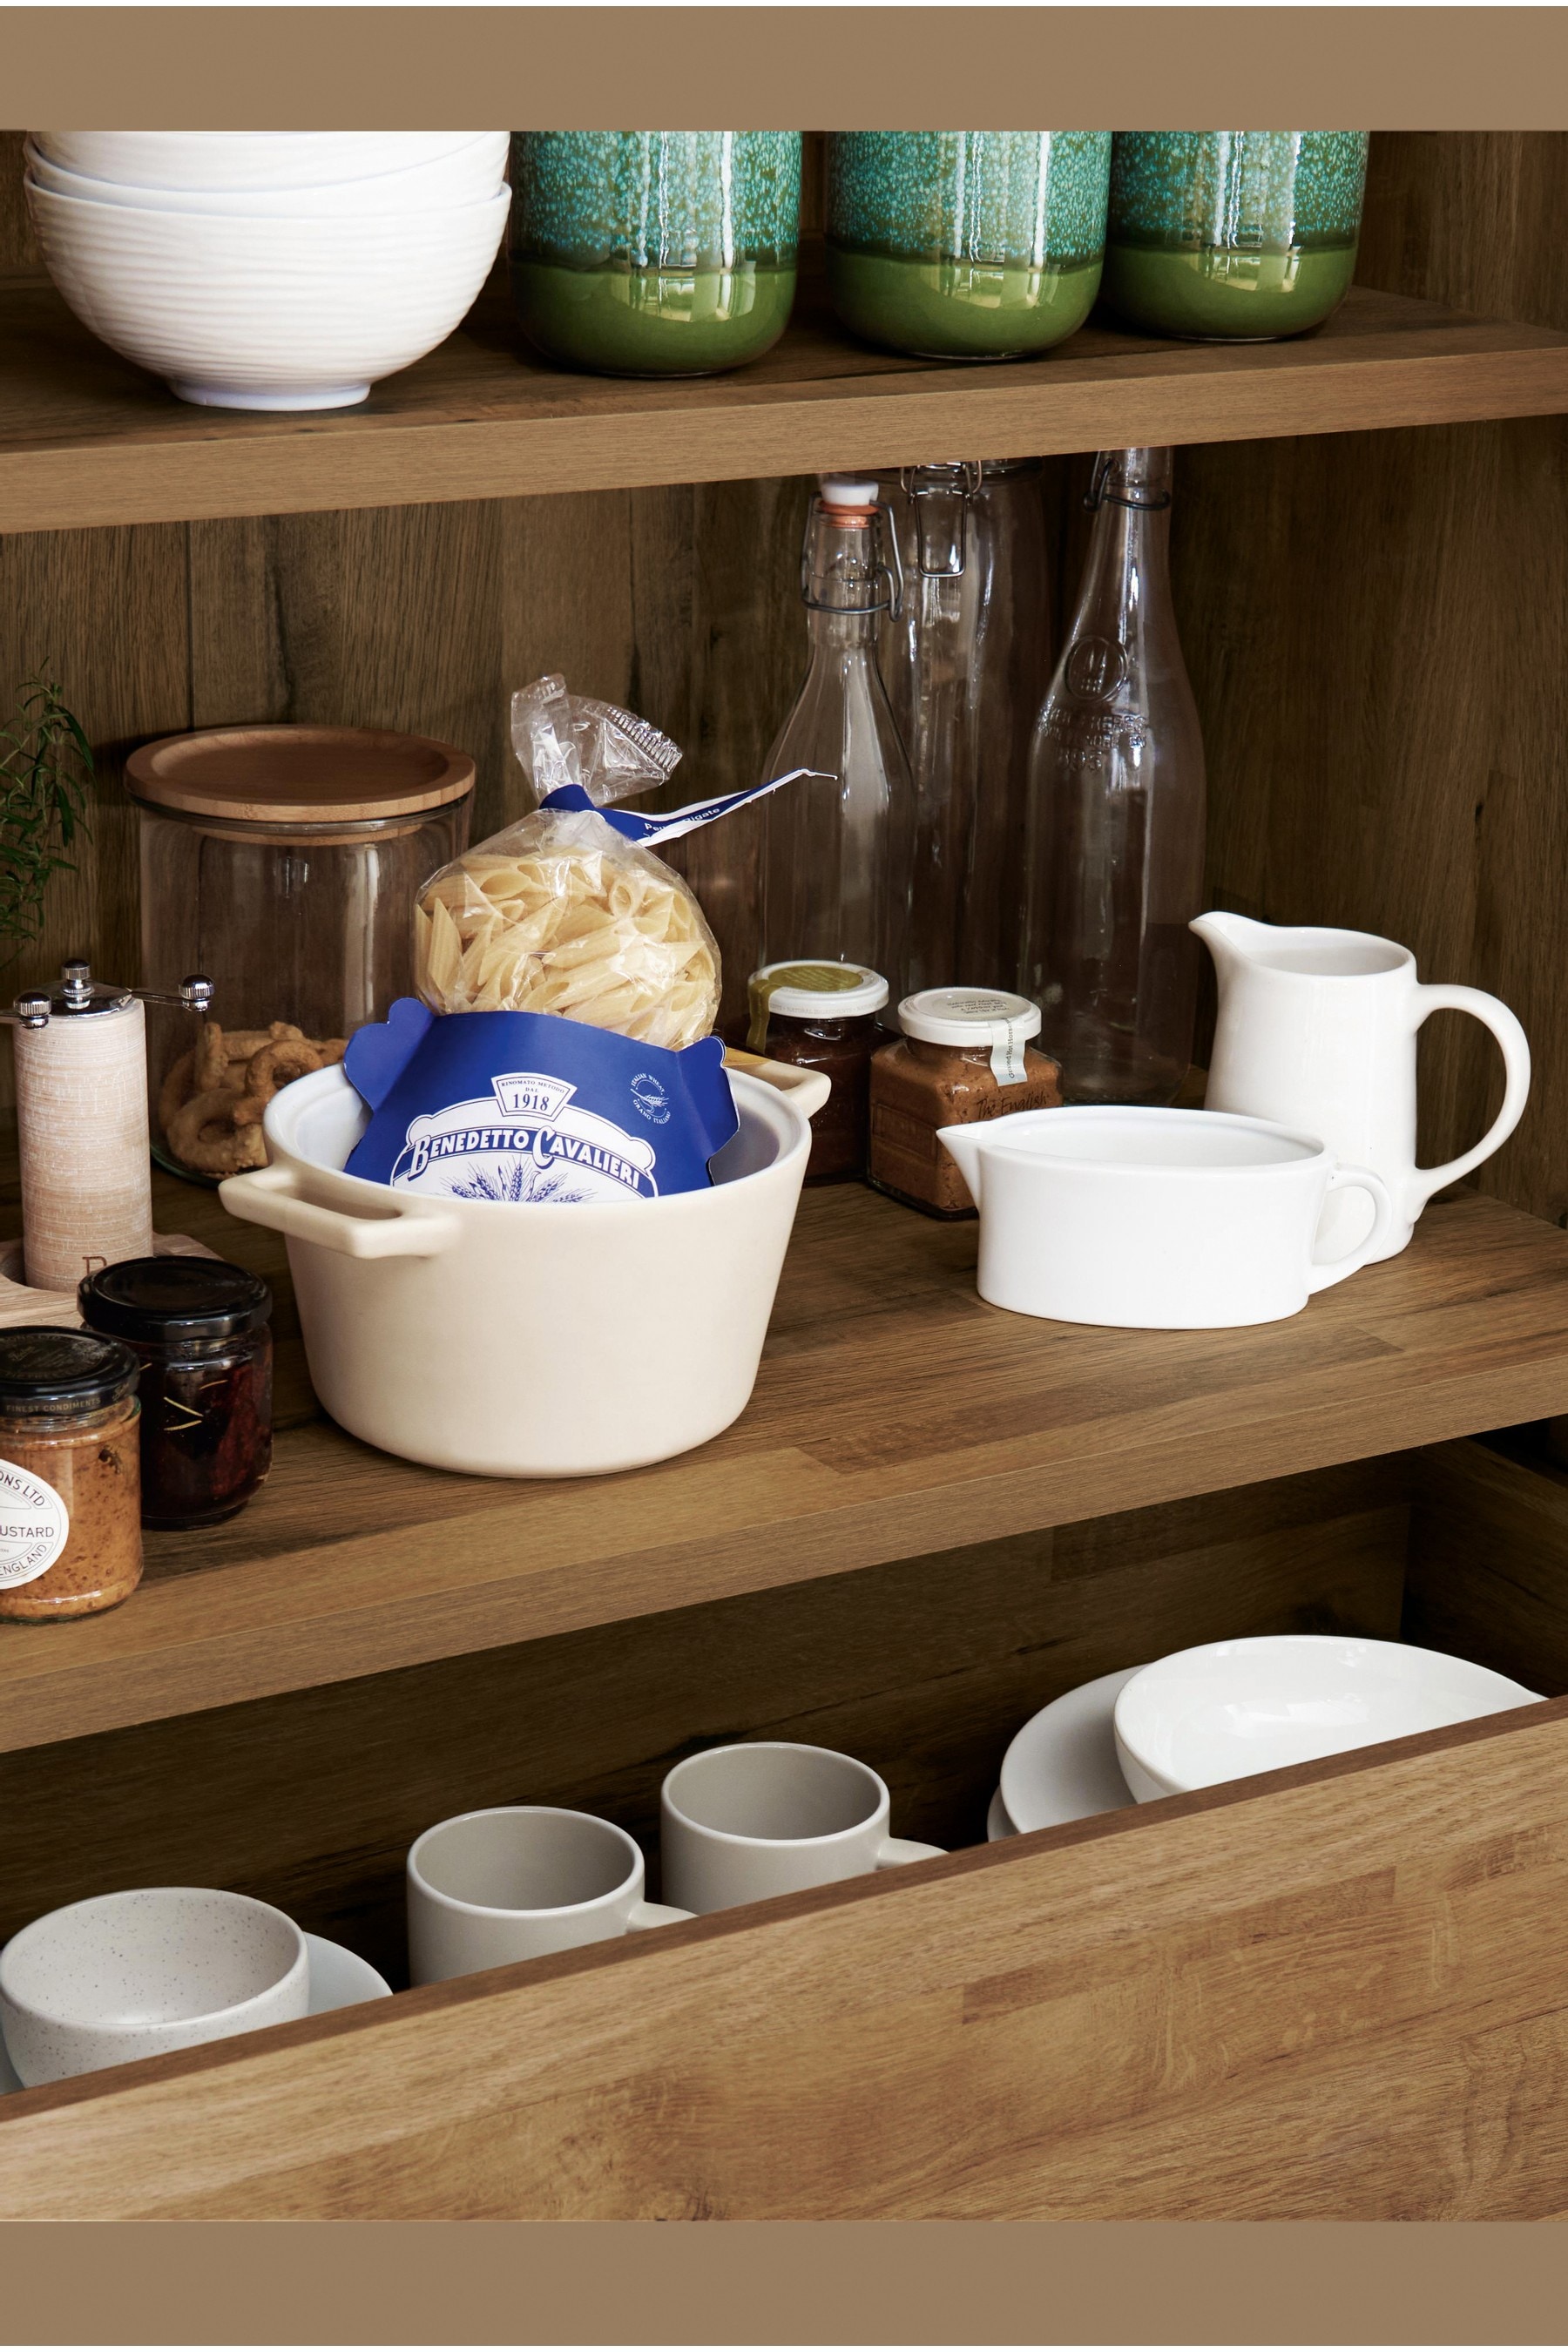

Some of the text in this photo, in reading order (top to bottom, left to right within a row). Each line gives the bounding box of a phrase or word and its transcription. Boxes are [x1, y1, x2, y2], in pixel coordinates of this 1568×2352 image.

[537, 1081, 565, 1094] METODO
[513, 1093, 550, 1112] 1918
[977, 1090, 1047, 1119] The English
[408, 1125, 640, 1190] BENEDETTO CAVALIERI
[6, 1396, 101, 1413] FINEST CONDIMENTS
[23, 1485, 45, 1507] LTD
